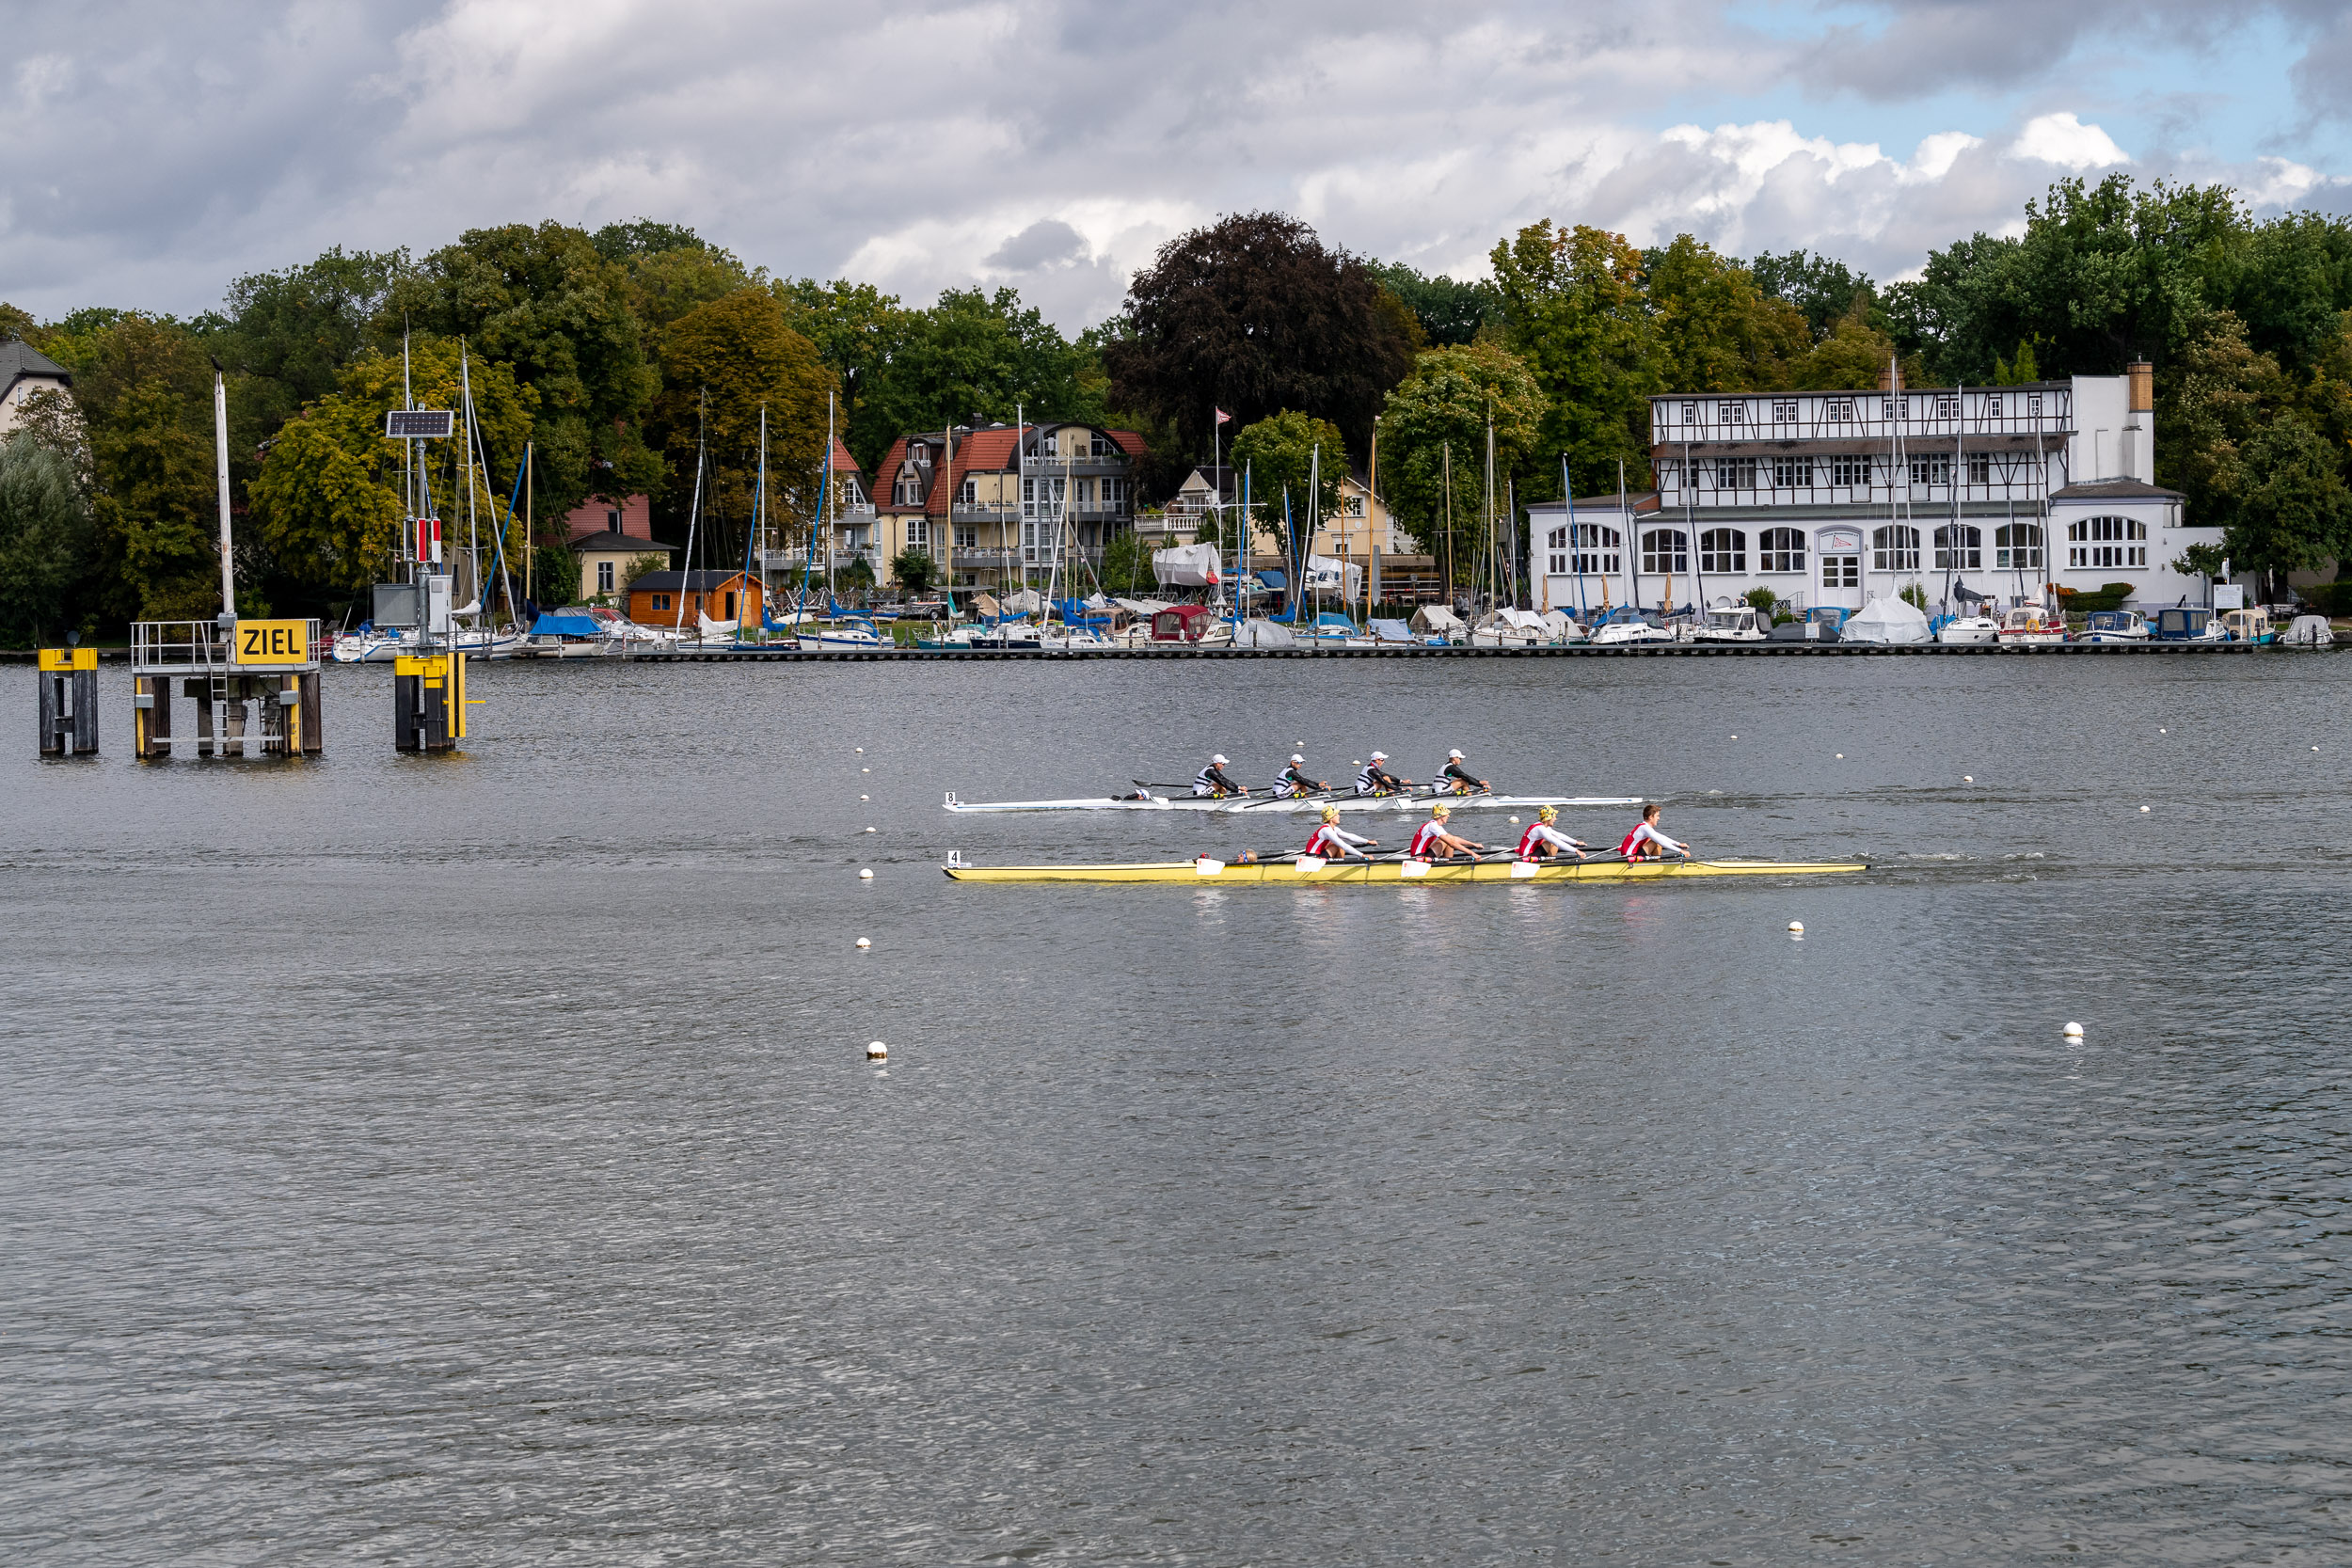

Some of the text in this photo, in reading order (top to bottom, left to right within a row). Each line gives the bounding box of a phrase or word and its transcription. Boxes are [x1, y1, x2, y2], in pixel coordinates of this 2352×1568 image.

[244, 629, 300, 655] ZIEL
[948, 792, 953, 802] 8
[952, 852, 957, 863] 4
